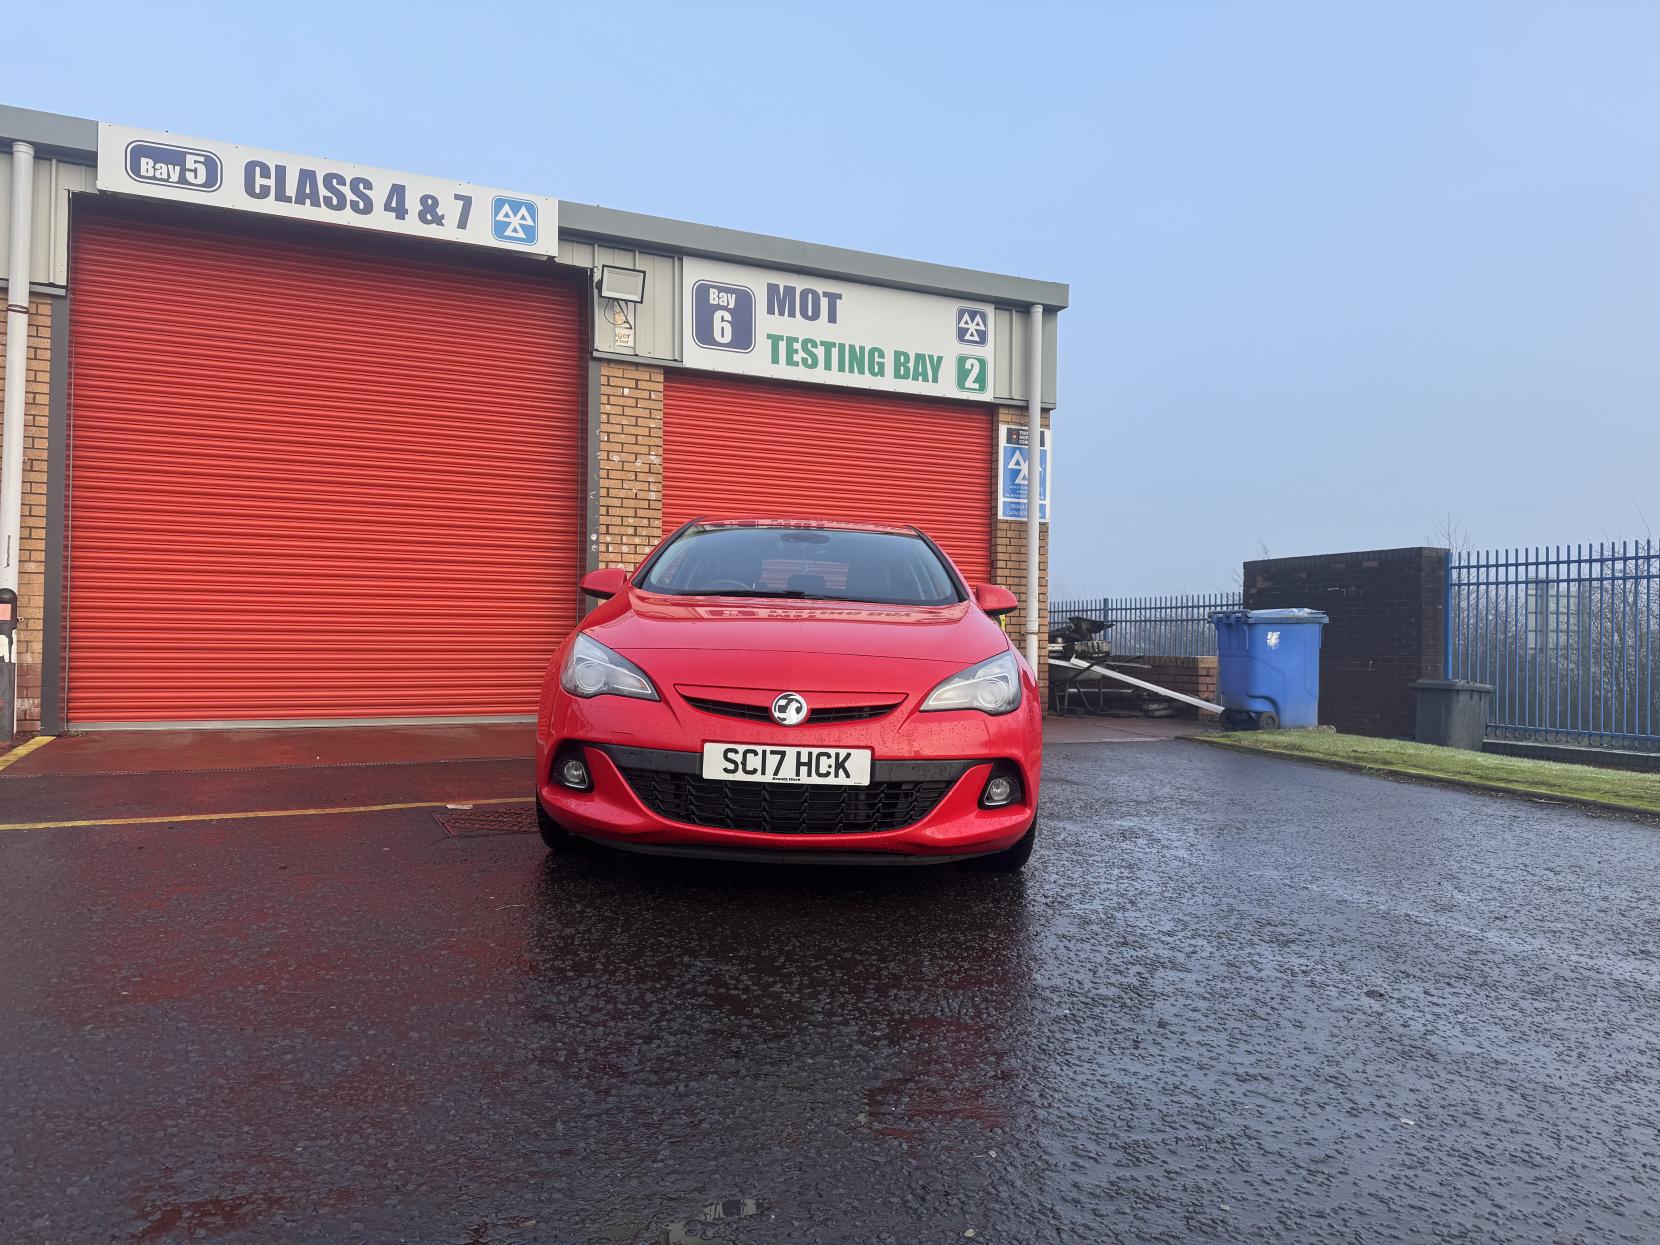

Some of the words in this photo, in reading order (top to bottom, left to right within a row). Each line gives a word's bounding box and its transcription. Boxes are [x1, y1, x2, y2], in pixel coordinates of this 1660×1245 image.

[140, 157, 181, 181] Bay
[184, 154, 207, 185] 5
[243, 159, 375, 216] CLASS
[383, 184, 408, 221] 4
[417, 194, 445, 227] &
[453, 193, 473, 230] 7
[709, 286, 737, 310] Bay
[766, 282, 843, 325] MOT
[712, 310, 733, 345] 6
[766, 333, 886, 378] TESTING
[893, 350, 944, 384] BAY
[964, 358, 982, 391] 2
[722, 748, 786, 777] SC17
[795, 752, 851, 779] HCK
